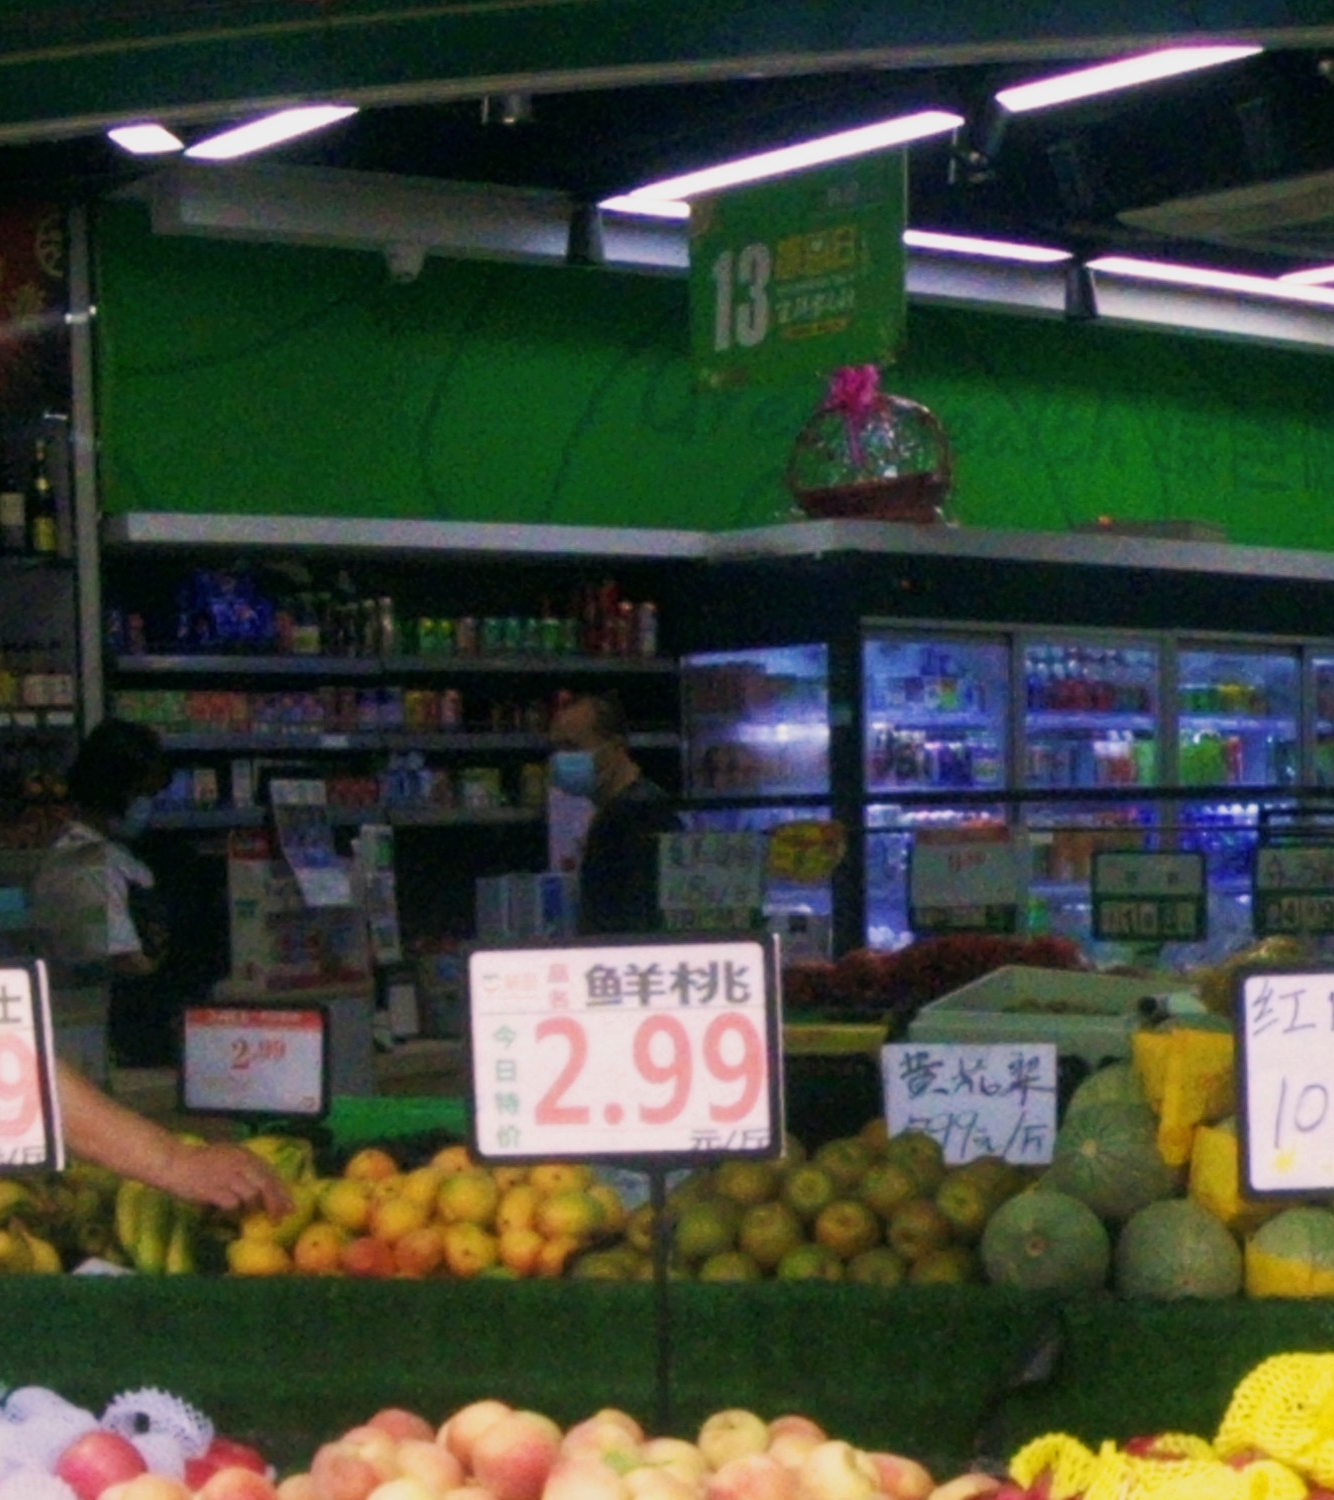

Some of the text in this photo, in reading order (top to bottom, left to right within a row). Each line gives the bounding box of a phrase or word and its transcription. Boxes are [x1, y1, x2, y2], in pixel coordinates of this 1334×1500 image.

[714, 242, 771, 352] 13
[584, 959, 752, 1008] 鲜桃
[533, 1011, 765, 1127] 2.99
